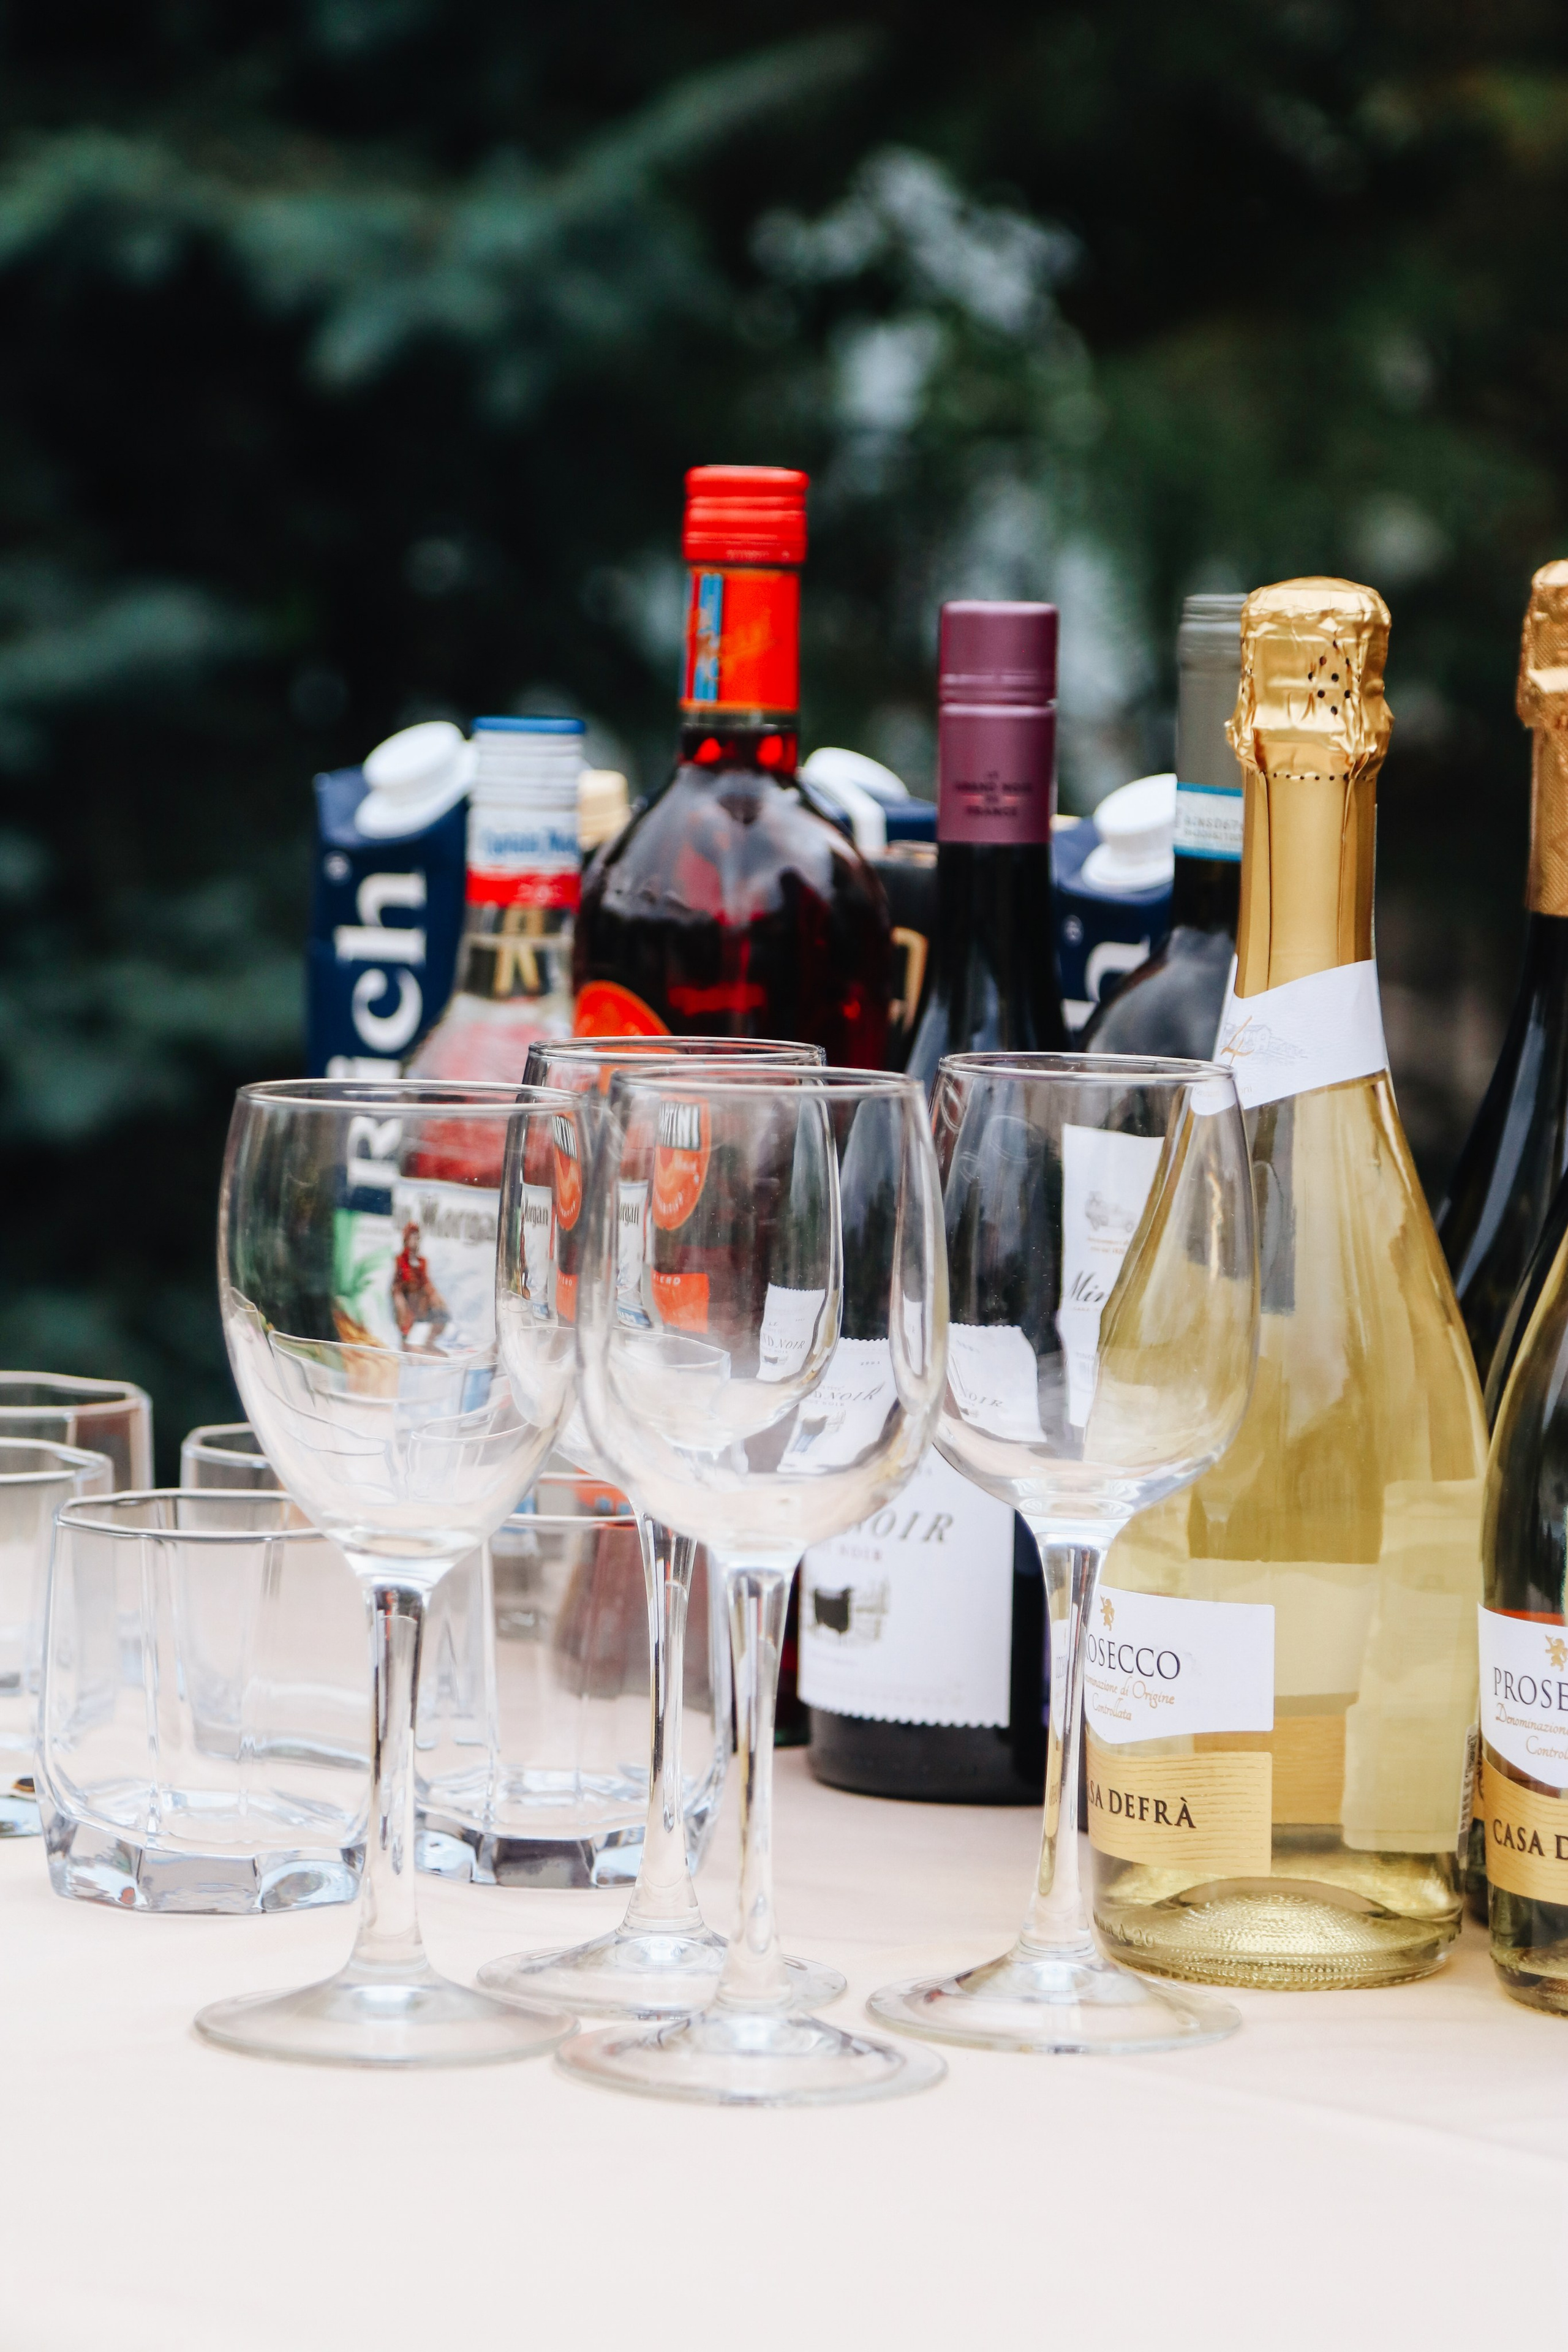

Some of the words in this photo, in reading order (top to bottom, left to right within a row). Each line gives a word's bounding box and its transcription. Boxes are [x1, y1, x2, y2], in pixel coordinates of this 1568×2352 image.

[1087, 1634, 1182, 1680] OSECCO
[1120, 1675, 1133, 1697] di
[1133, 1680, 1175, 1709] Origine
[1493, 1666, 1568, 1712] PROSE
[1526, 1735, 1568, 1760] Control
[1088, 1780, 1104, 1811] SA
[1108, 1785, 1197, 1829] DEFRÀ
[1493, 1818, 1545, 1857] CASA
[1554, 1834, 1568, 1861] D
